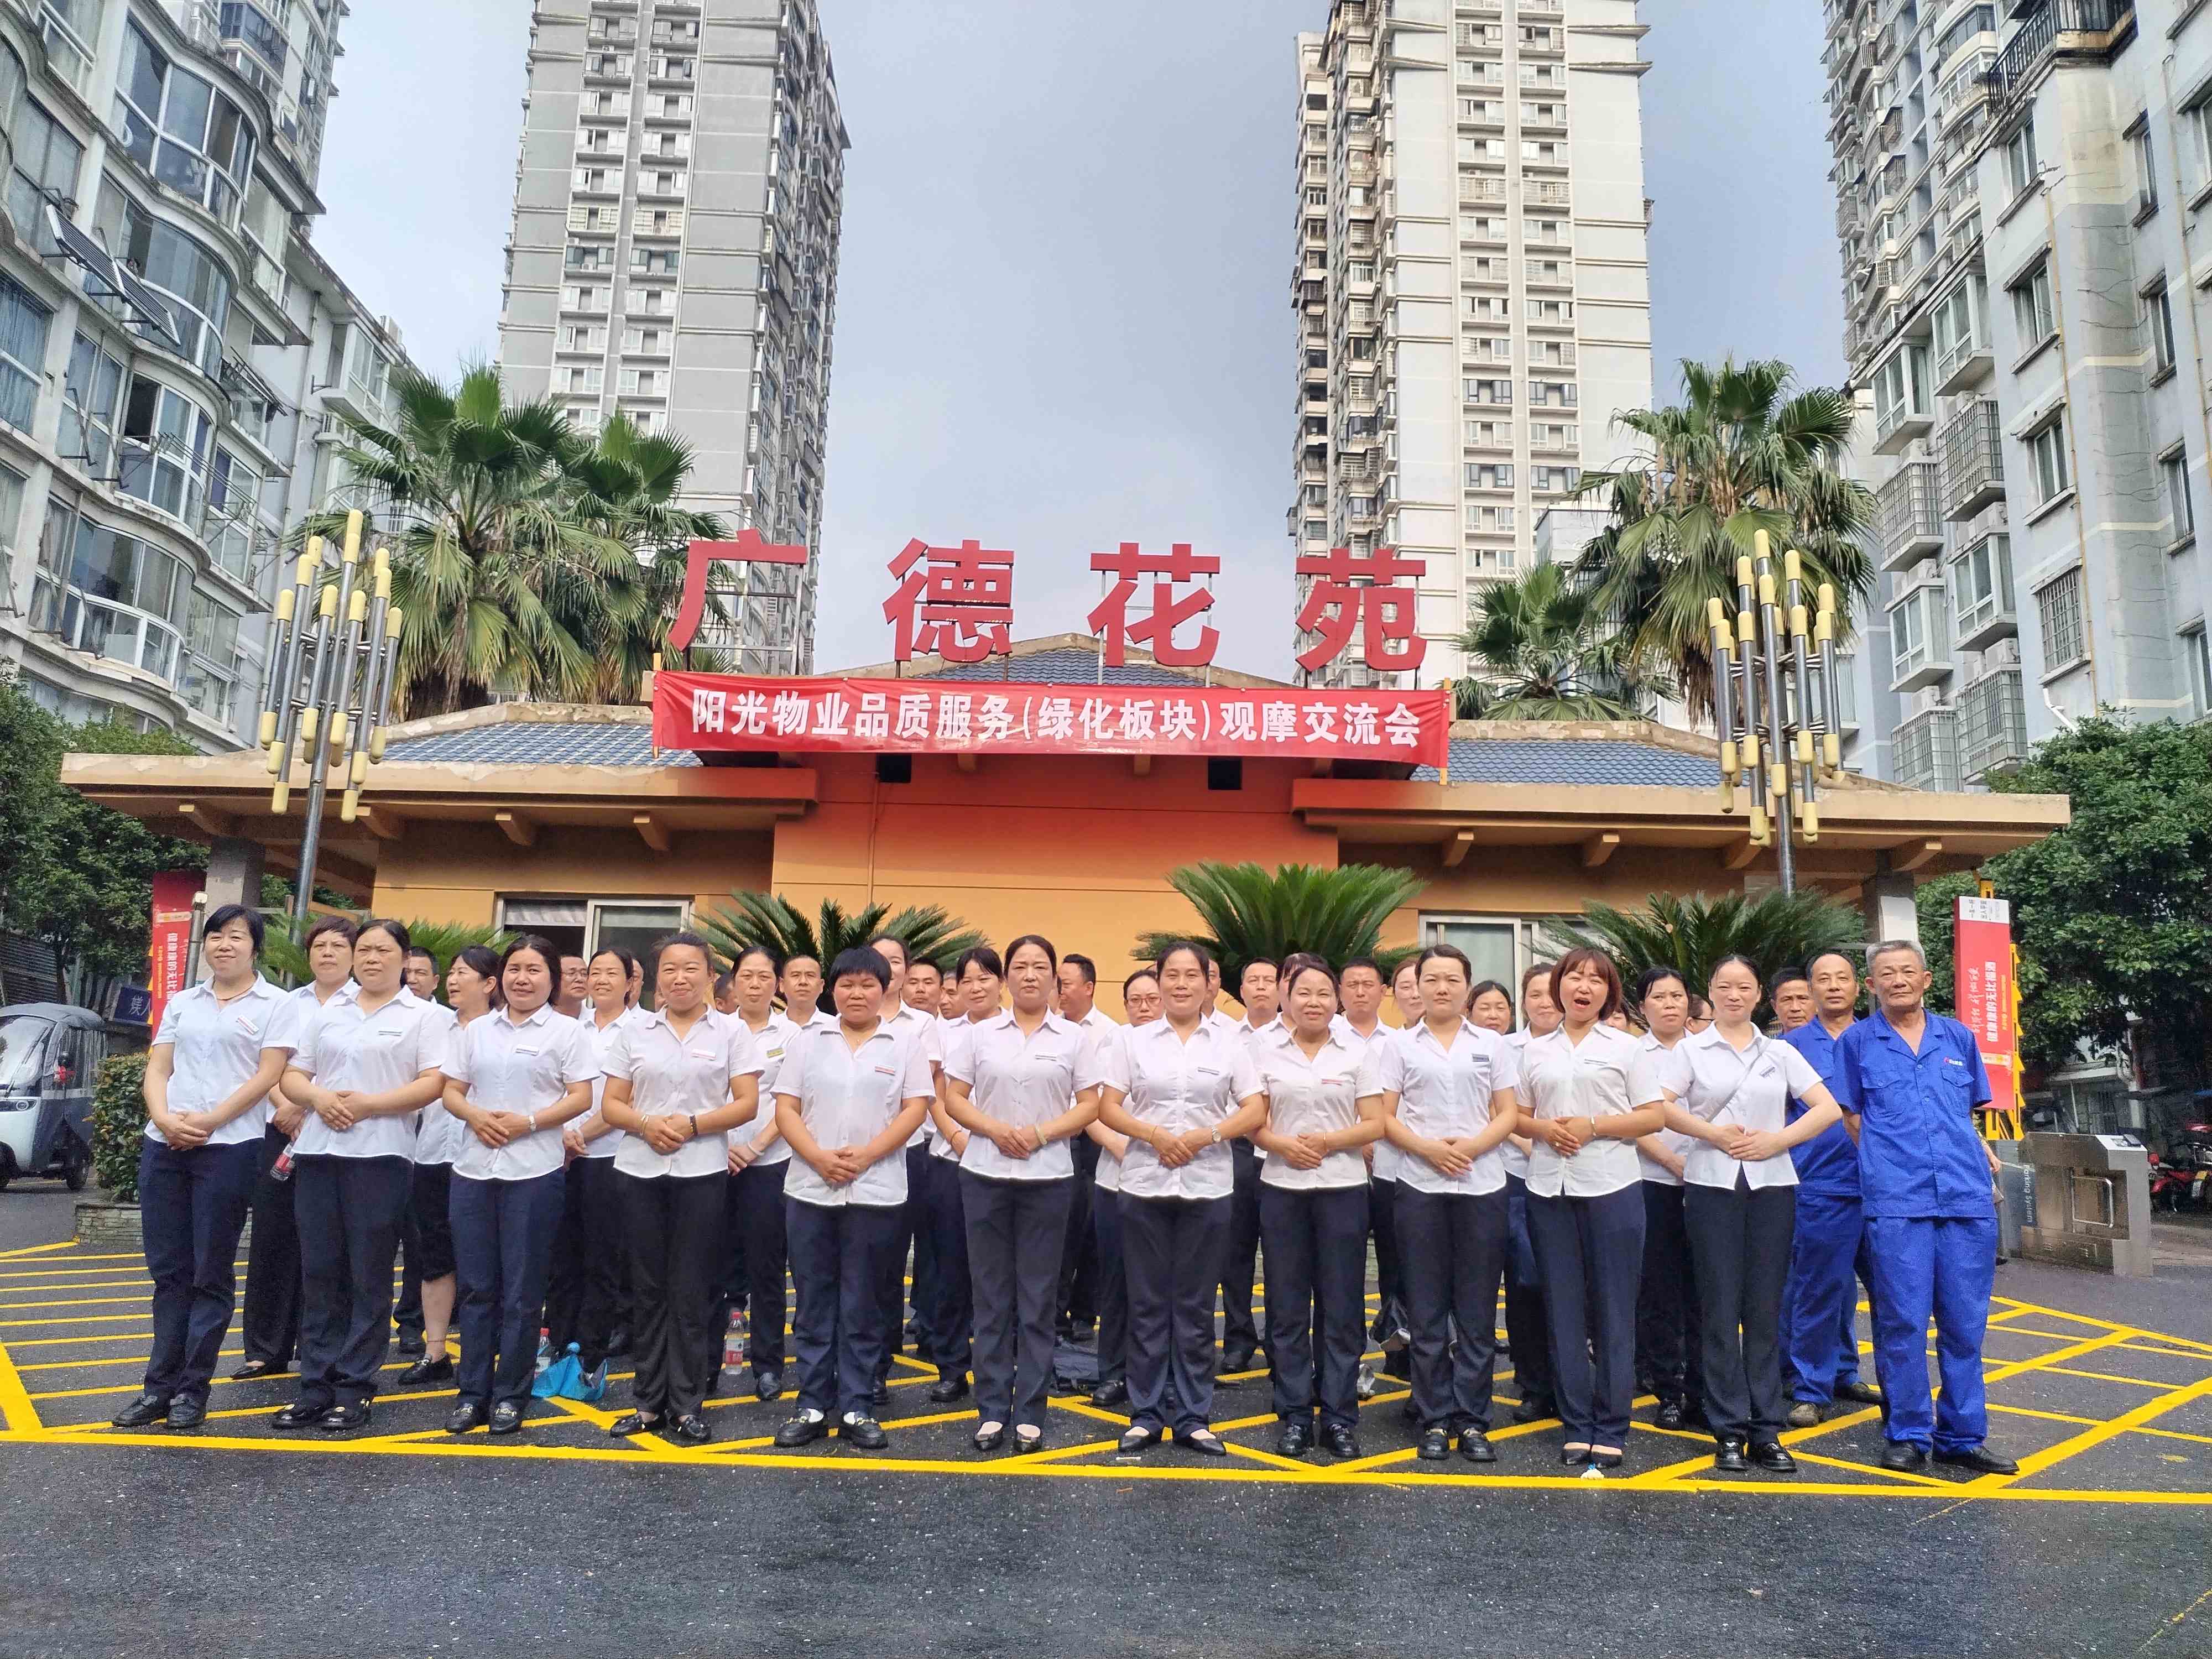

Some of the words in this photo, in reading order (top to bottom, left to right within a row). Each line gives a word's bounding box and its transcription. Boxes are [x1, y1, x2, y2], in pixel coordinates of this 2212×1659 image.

[669, 529, 1428, 671] 广德花苑
[692, 688, 1421, 748] 阳光物业品质服务(绿化板块)观摩交流会
